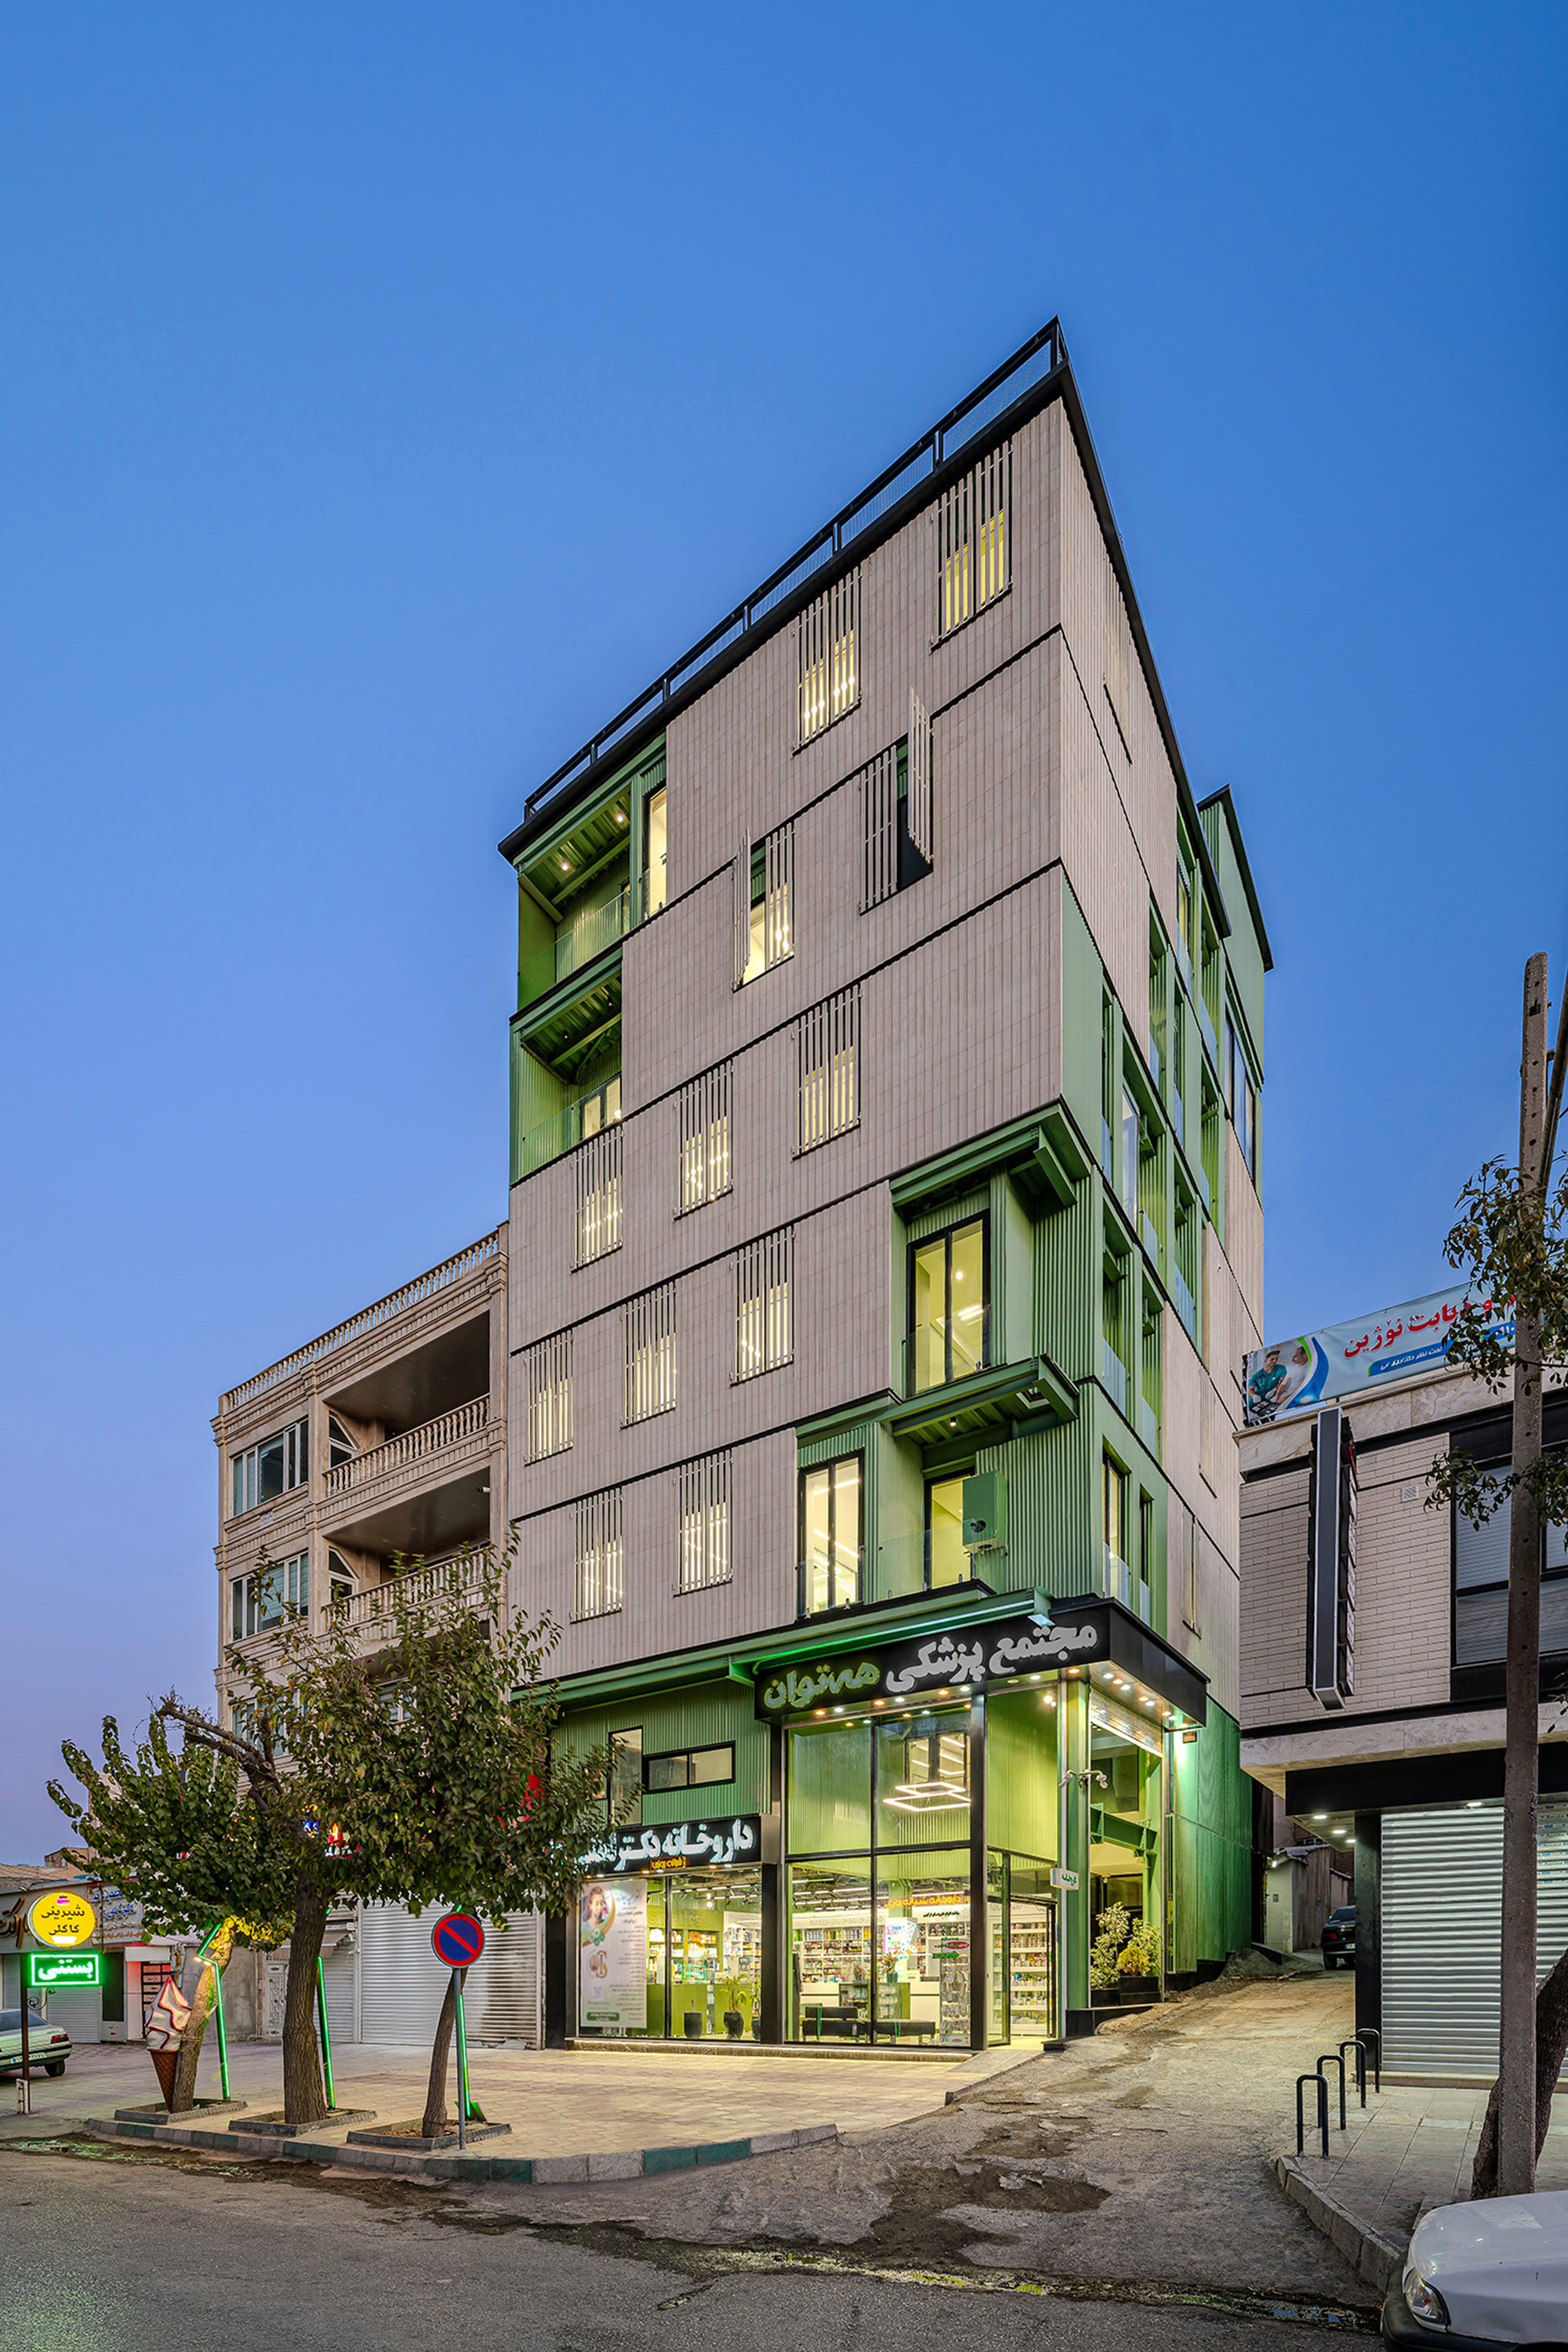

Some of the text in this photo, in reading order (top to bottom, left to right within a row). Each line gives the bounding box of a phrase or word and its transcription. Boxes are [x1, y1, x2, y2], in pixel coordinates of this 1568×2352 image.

[885, 1636, 985, 1693] پزشکی
[989, 1624, 1098, 1675] مجتمع
[613, 1829, 662, 1871] دکتر
[662, 1818, 754, 1864] داروخانه
[41, 1904, 85, 1920] شیرینی
[38, 1958, 94, 1980] بستنی
